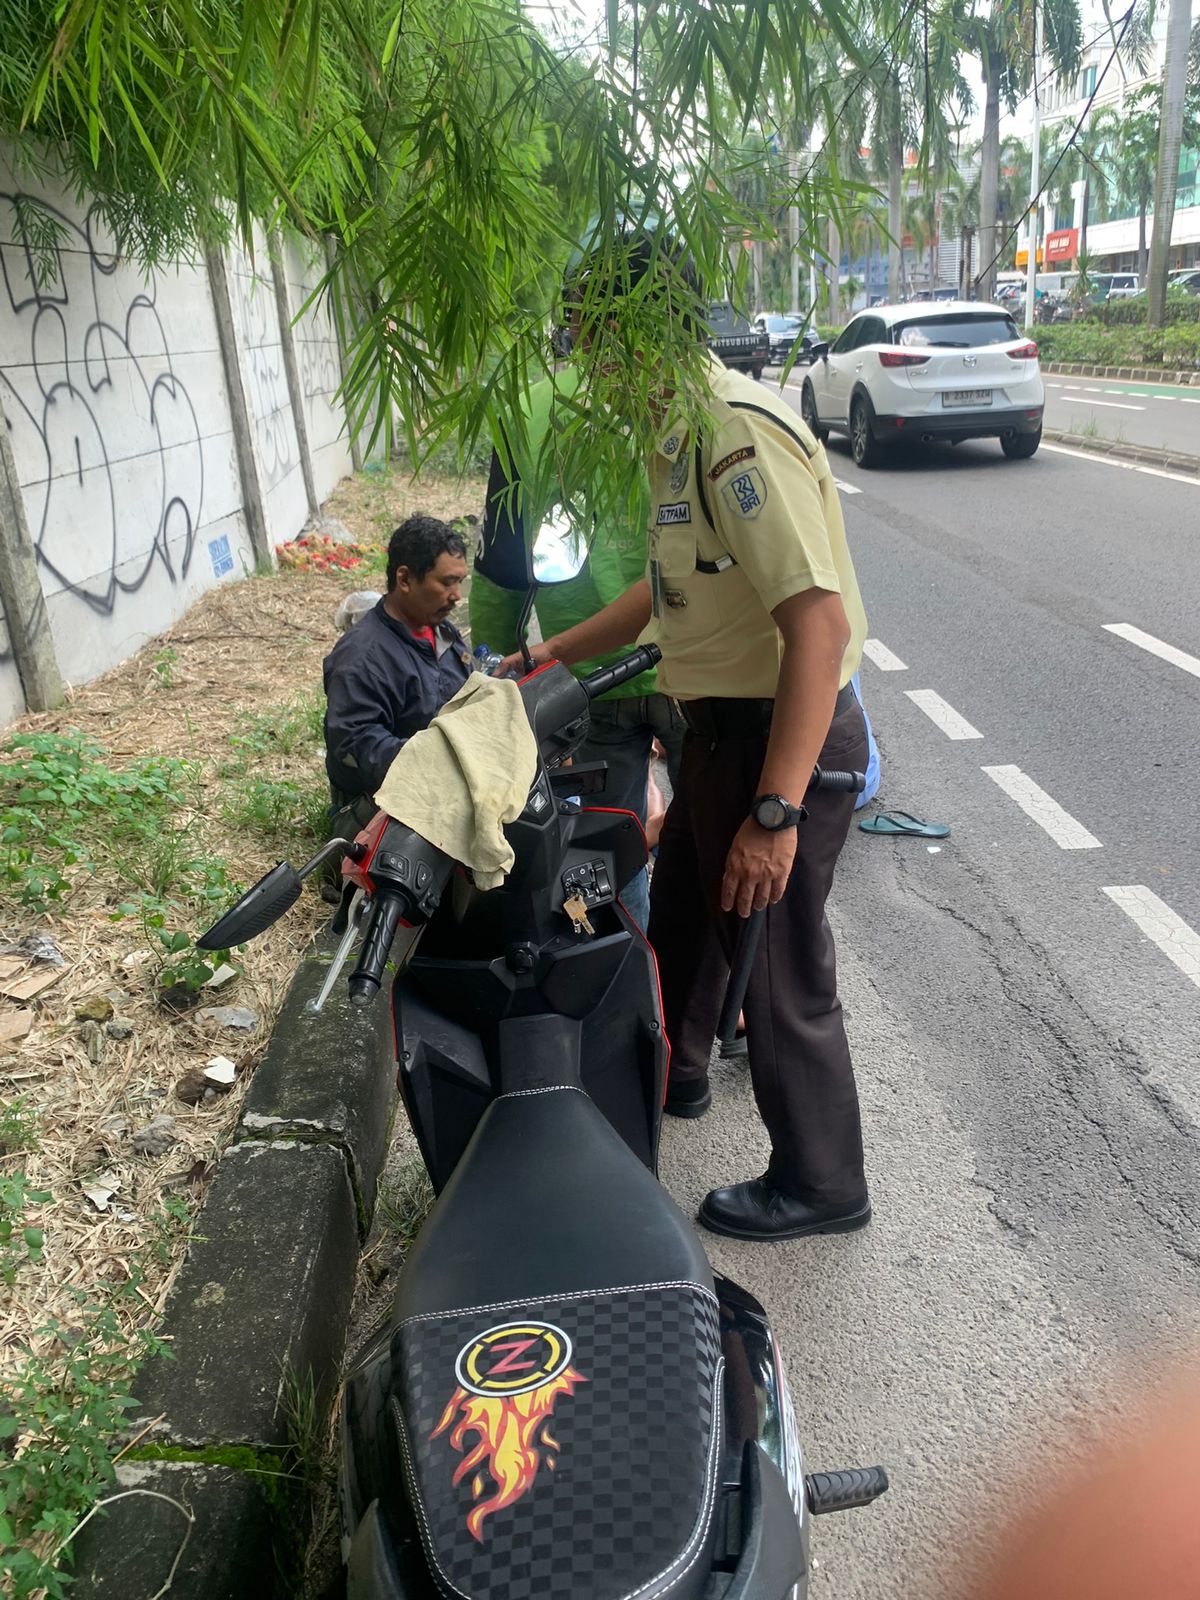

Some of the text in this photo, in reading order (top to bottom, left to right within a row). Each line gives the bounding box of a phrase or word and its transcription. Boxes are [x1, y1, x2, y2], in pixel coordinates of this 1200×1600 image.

[715, 451, 749, 473] JAKARTA
[740, 494, 760, 513] BRI
[485, 1338, 539, 1375] Z
